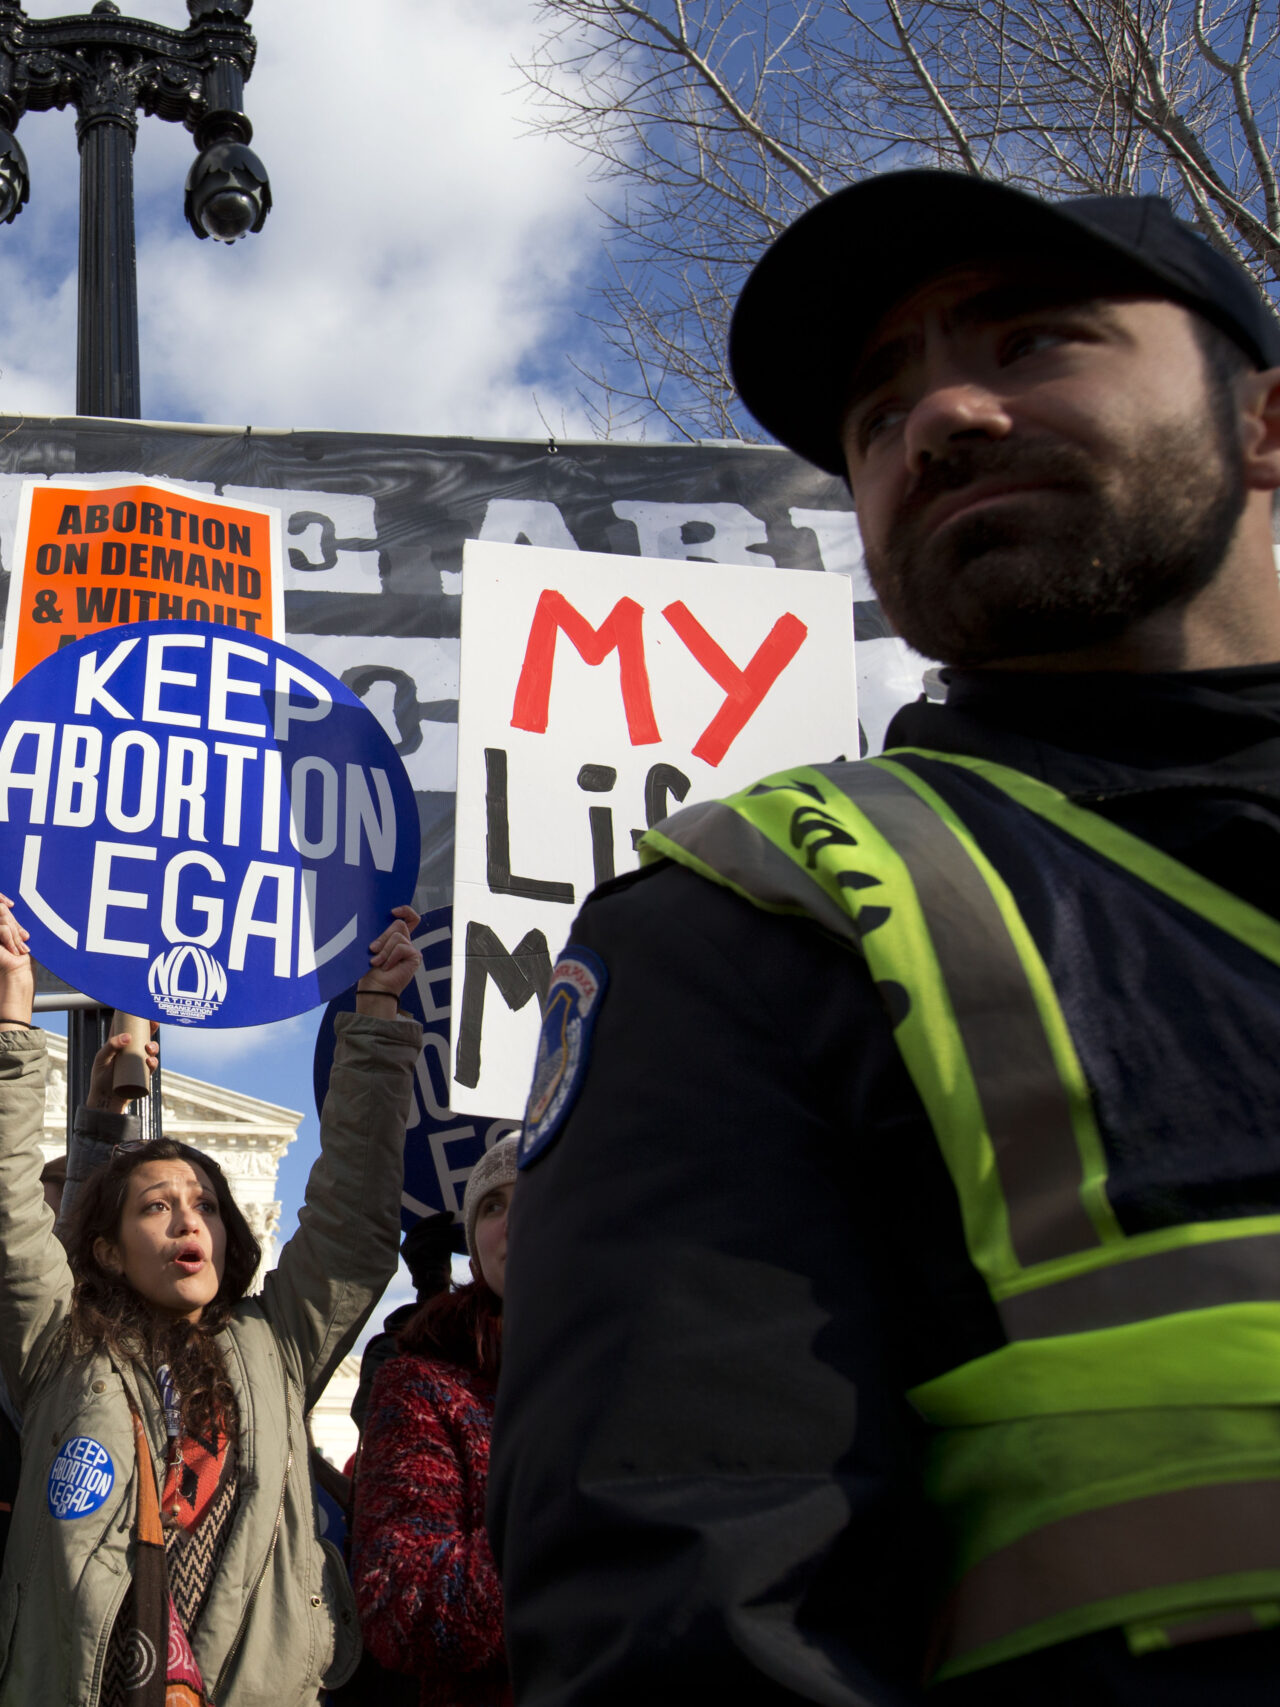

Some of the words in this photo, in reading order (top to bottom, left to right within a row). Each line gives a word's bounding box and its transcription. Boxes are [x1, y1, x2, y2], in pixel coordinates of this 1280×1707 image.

[57, 501, 251, 557] ABORTION
[36, 542, 90, 575] ON
[101, 541, 261, 600] DEMAND
[31, 589, 63, 624] &
[74, 634, 333, 741] KEEP
[511, 589, 808, 767] MY
[19, 835, 358, 978] LEGAL
[148, 946, 227, 1002] NOW
[51, 1456, 113, 1497] ABORTION
[63, 1437, 109, 1467] KEEP
[50, 1480, 95, 1512] LEGAL
